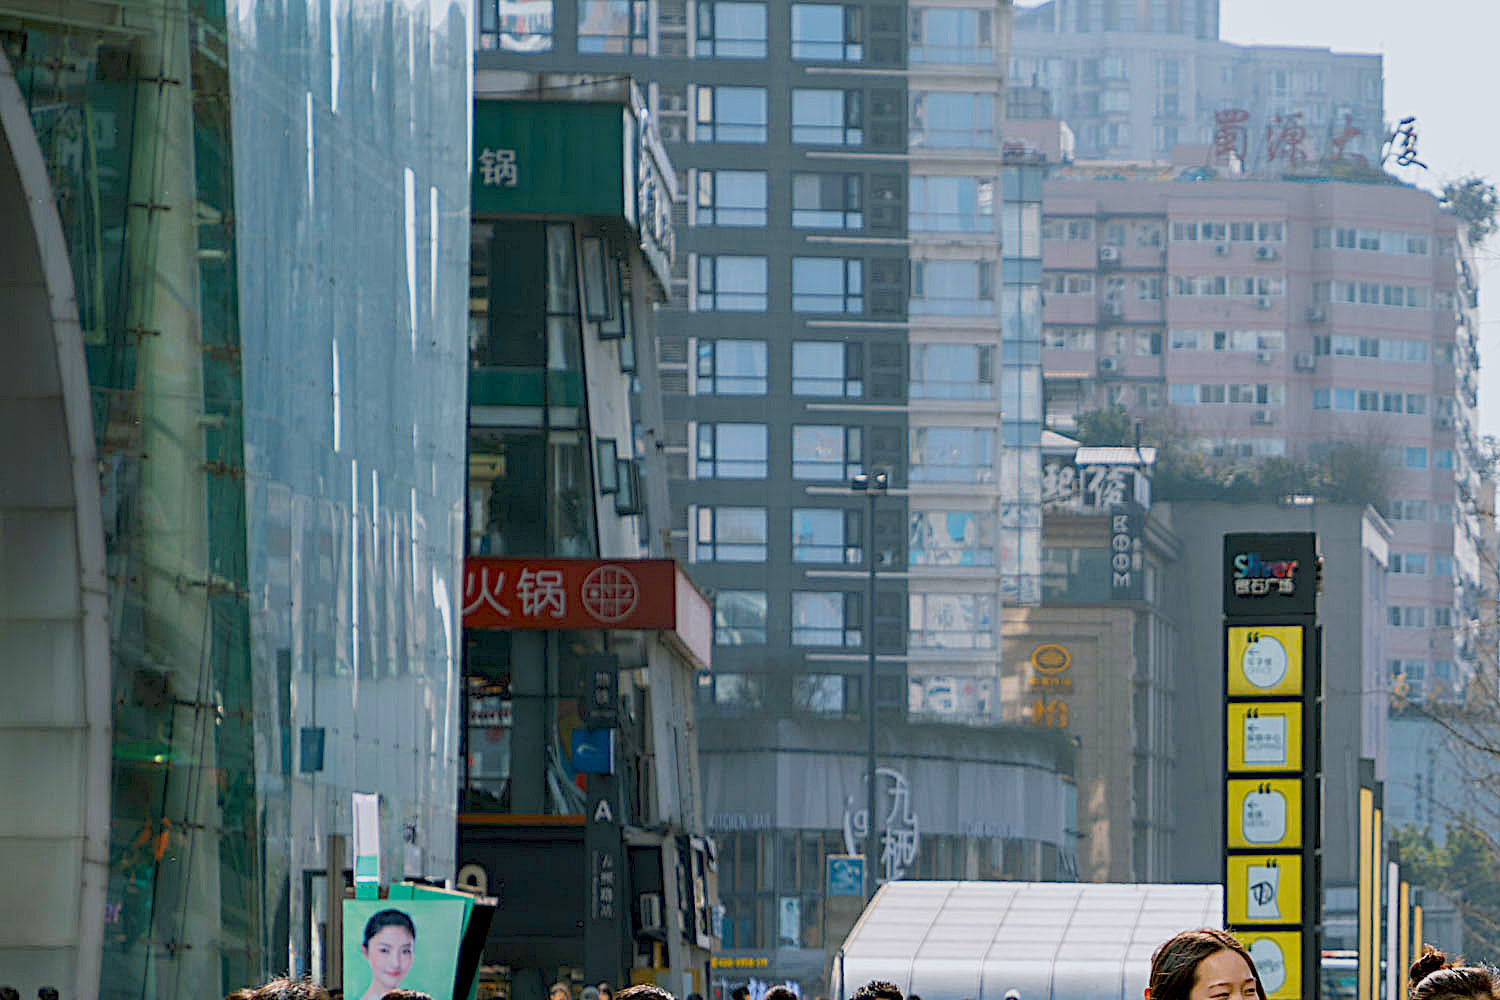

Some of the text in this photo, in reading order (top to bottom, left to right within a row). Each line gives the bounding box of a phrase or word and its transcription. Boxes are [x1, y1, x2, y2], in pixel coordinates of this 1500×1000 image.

[1213, 108, 1429, 170] 蜀源大厦
[478, 149, 518, 187] 锅
[463, 566, 567, 617] 火锅
